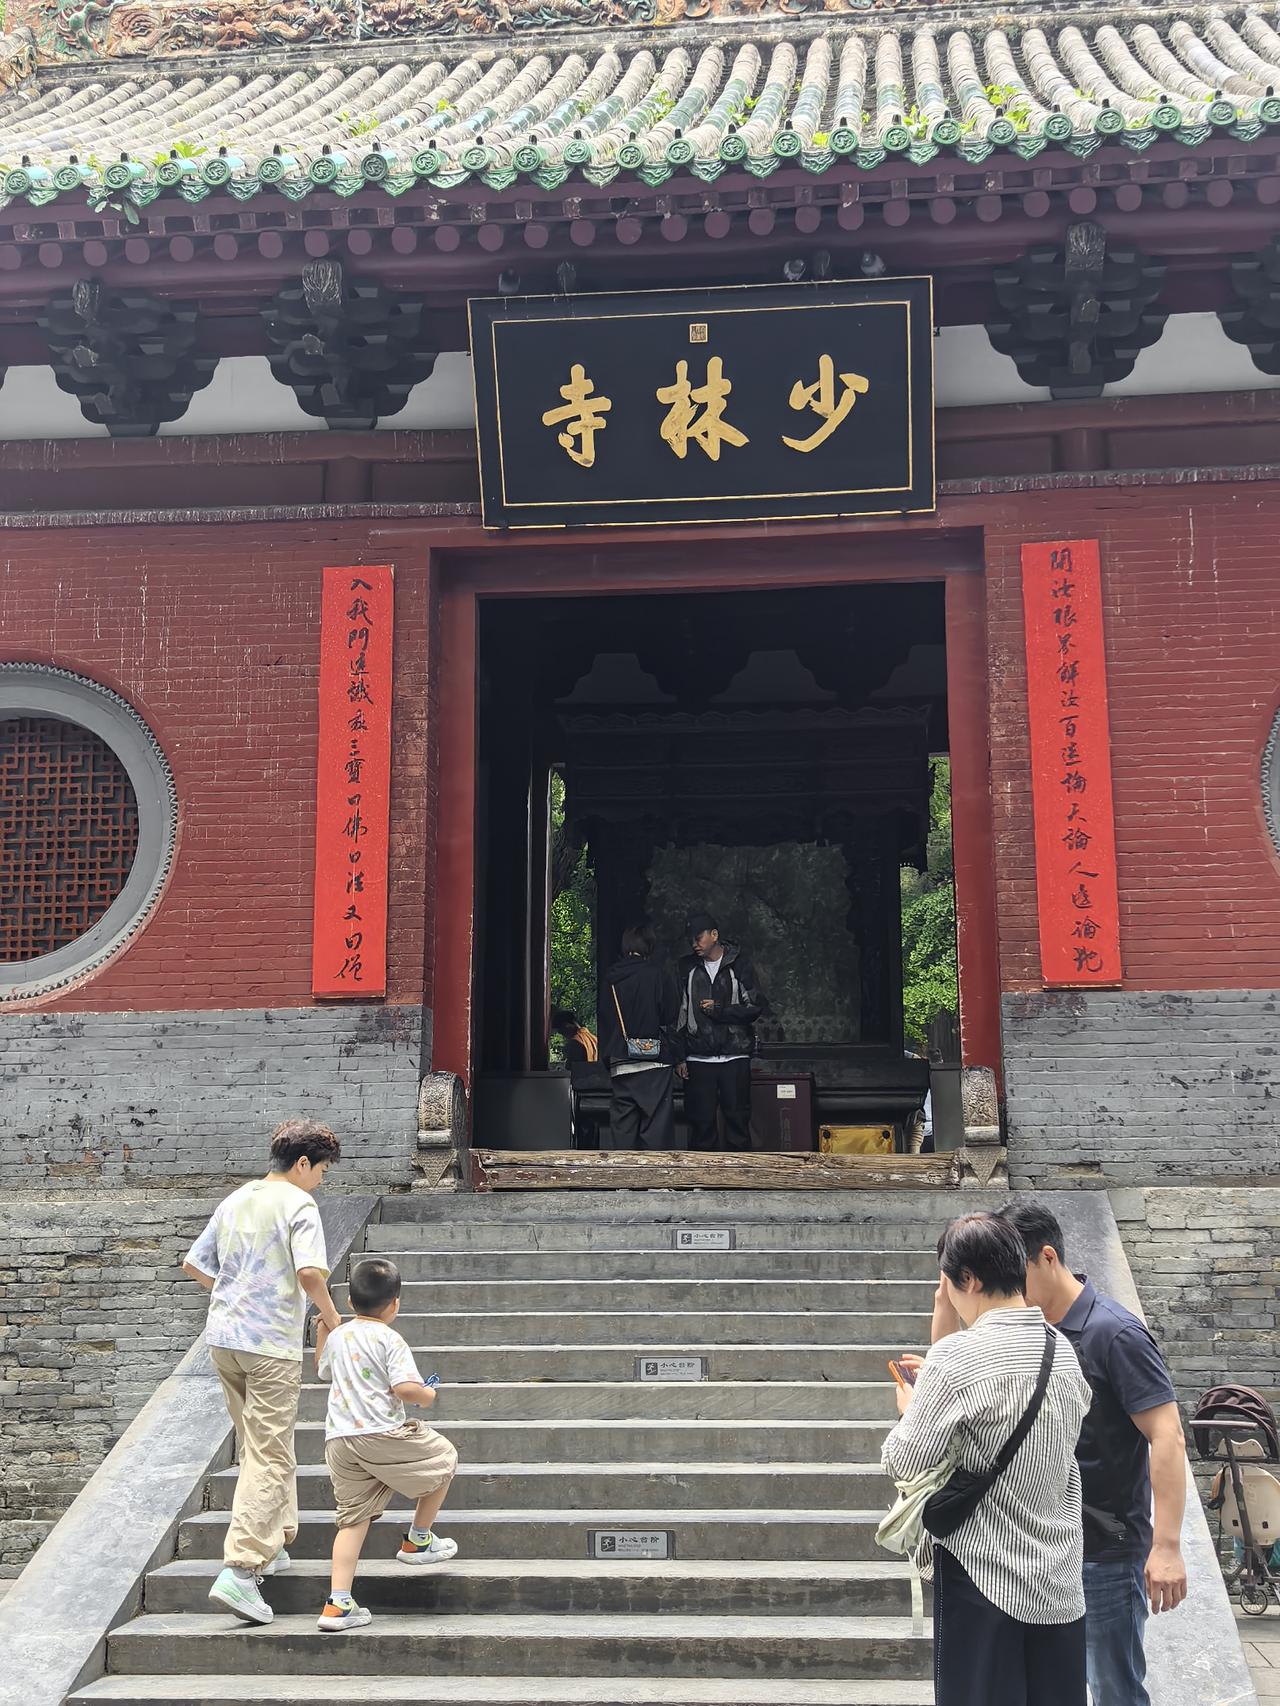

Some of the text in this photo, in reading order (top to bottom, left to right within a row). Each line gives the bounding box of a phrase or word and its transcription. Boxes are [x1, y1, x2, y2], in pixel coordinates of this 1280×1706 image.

[542, 353, 870, 468] 少林寺
[618, 1536, 660, 1544] 小心台阶
